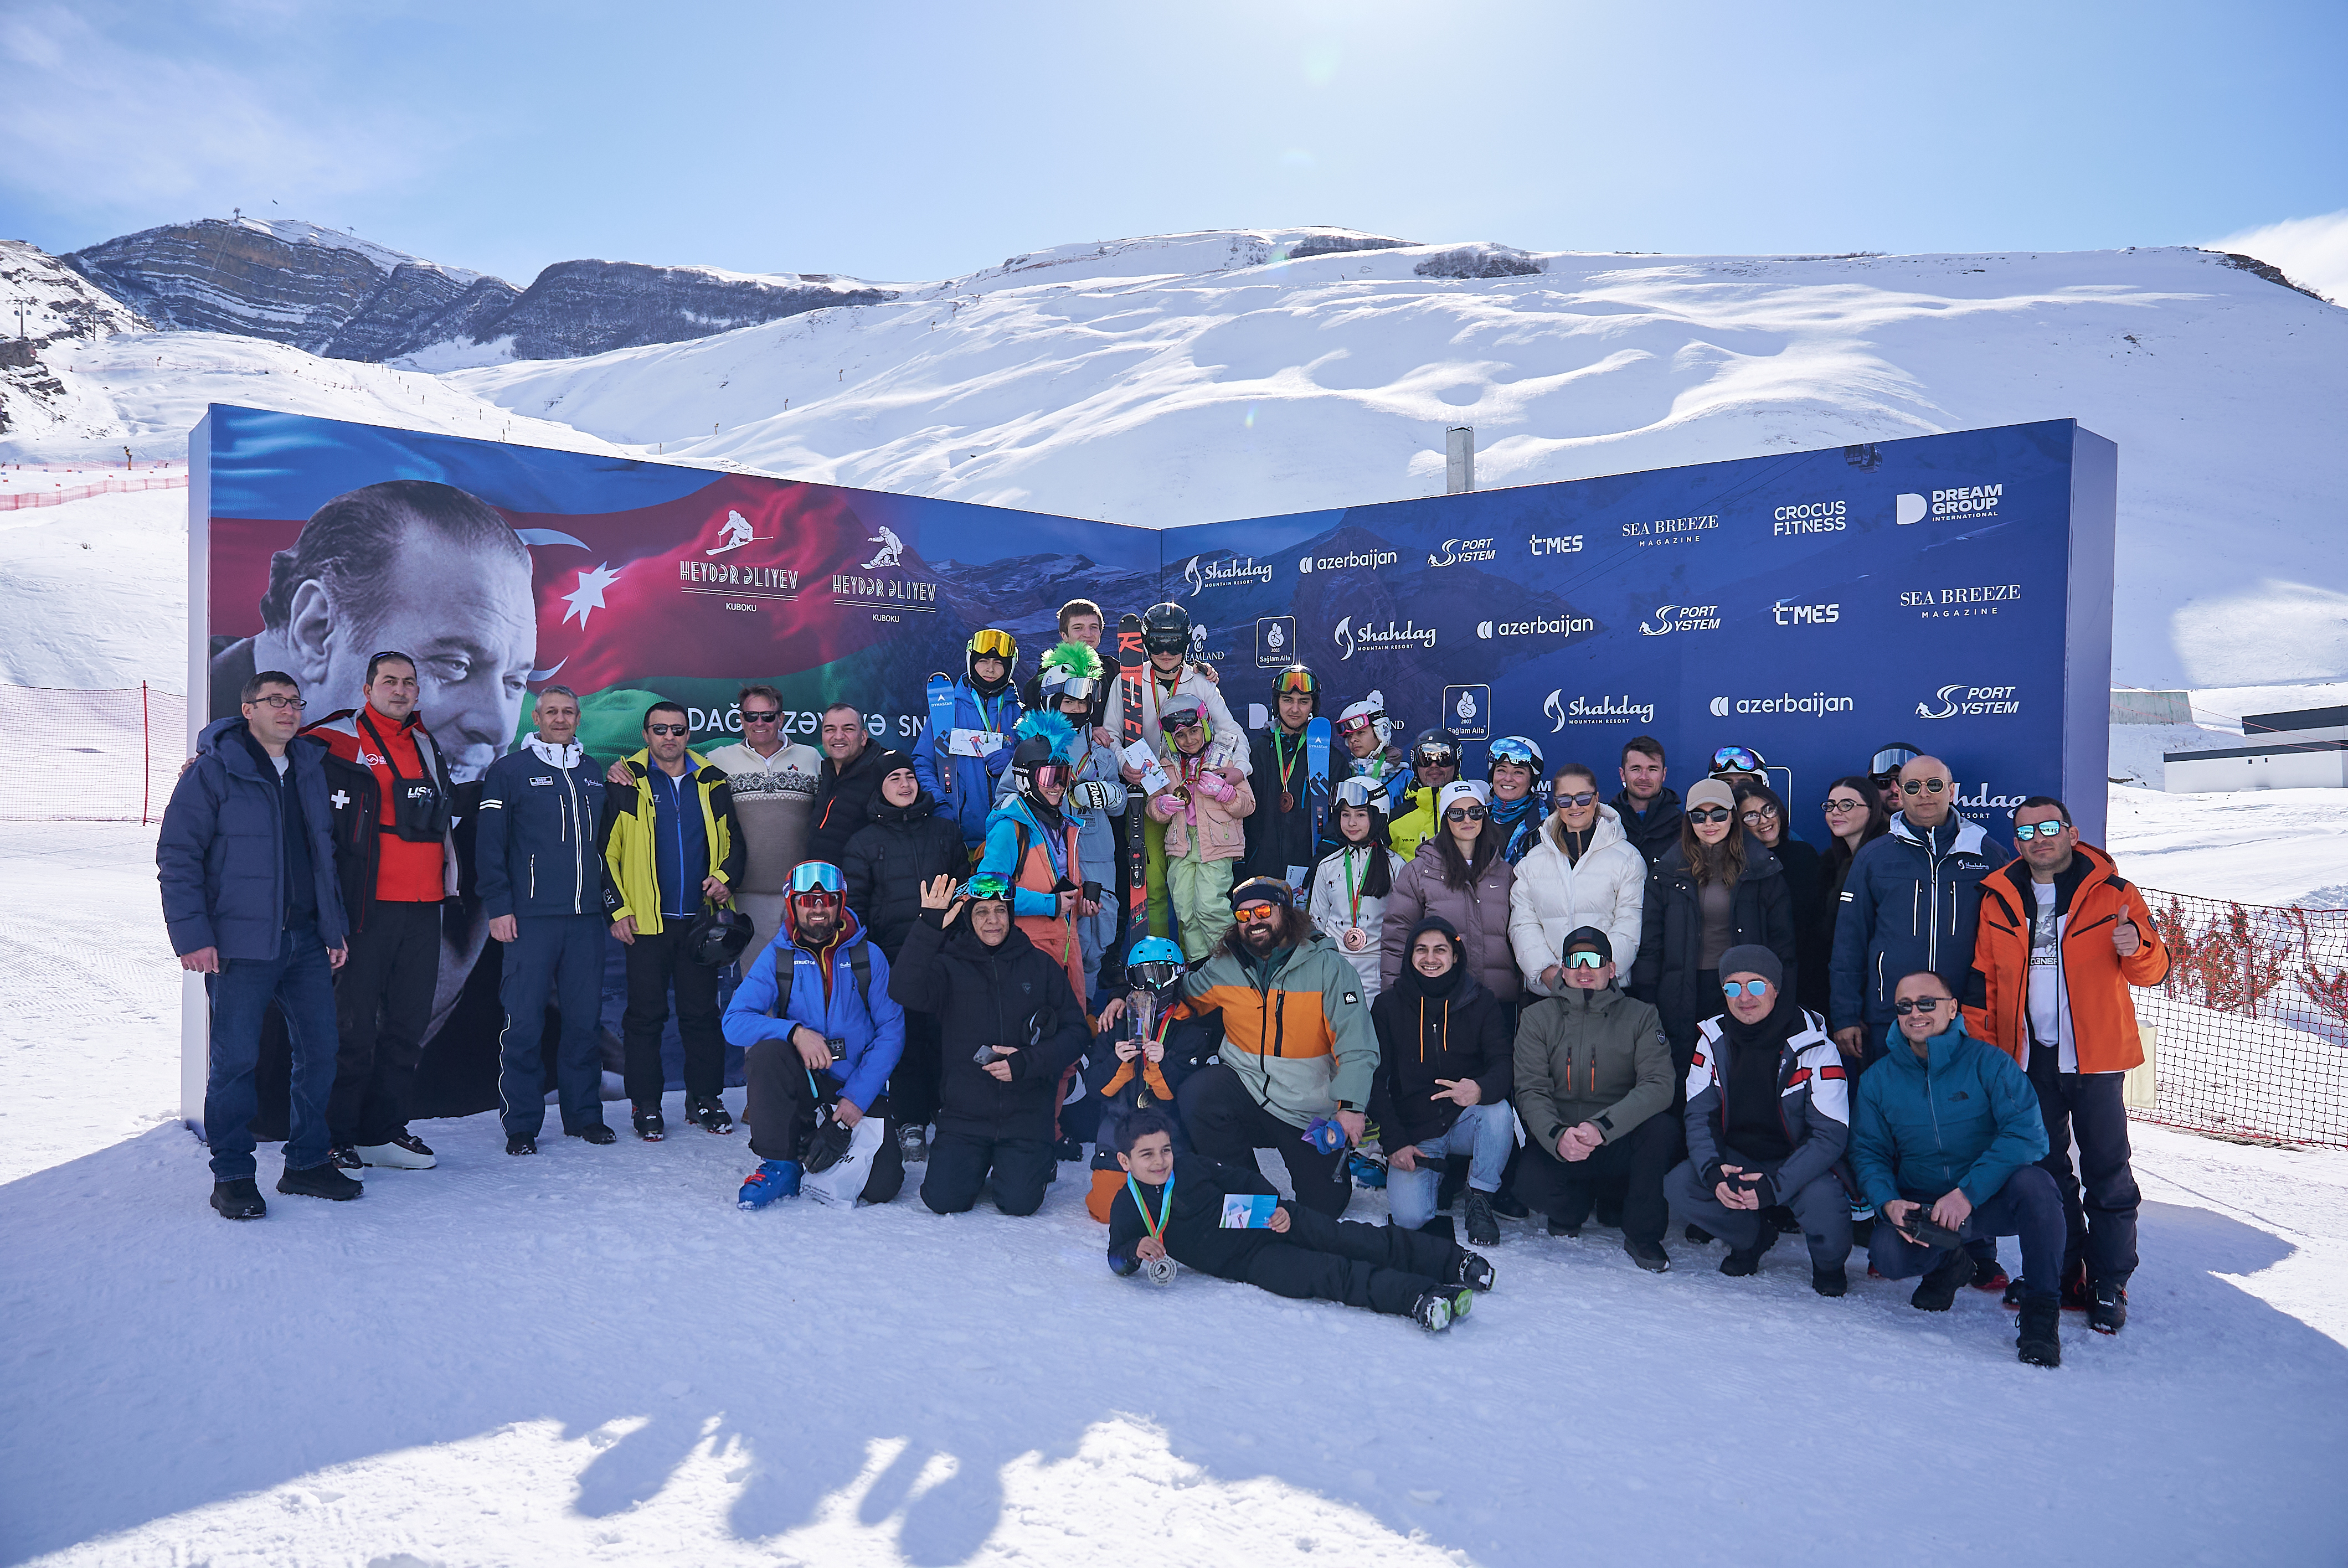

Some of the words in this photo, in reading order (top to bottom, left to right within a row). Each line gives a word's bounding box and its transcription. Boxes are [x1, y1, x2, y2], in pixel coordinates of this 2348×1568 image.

[1932, 483, 2002, 502] DREAM
[1774, 501, 1846, 520] CROCUS
[1932, 497, 1998, 515] GROUP
[1622, 522, 1651, 537] SEA
[1655, 515, 1718, 534] BREEZE
[1932, 511, 1998, 522] INTERNATIONAL
[1639, 535, 1701, 547] MAGAZINE
[1317, 549, 1397, 570] azerbaijan
[1204, 557, 1272, 583] Shahdag
[1900, 591, 1935, 607] SEA
[1940, 584, 2021, 604] BREEZE
[725, 602, 757, 612] KUBOKU
[1922, 607, 1998, 618] MAGAZINE
[872, 613, 899, 623] KUBOKU
[1498, 614, 1593, 638] azerbaijan
[1357, 620, 1436, 648] Shahdag
[1186, 651, 1224, 662] EAMLAND
[1569, 695, 1654, 724] Shahdag
[1736, 692, 1853, 718] azerbaijan
[688, 702, 742, 732] DAĞ
[781, 710, 824, 734] ZƏ
[899, 715, 927, 737] SN
[1953, 782, 2026, 819] hdag
[2031, 957, 2057, 966] OGNER
